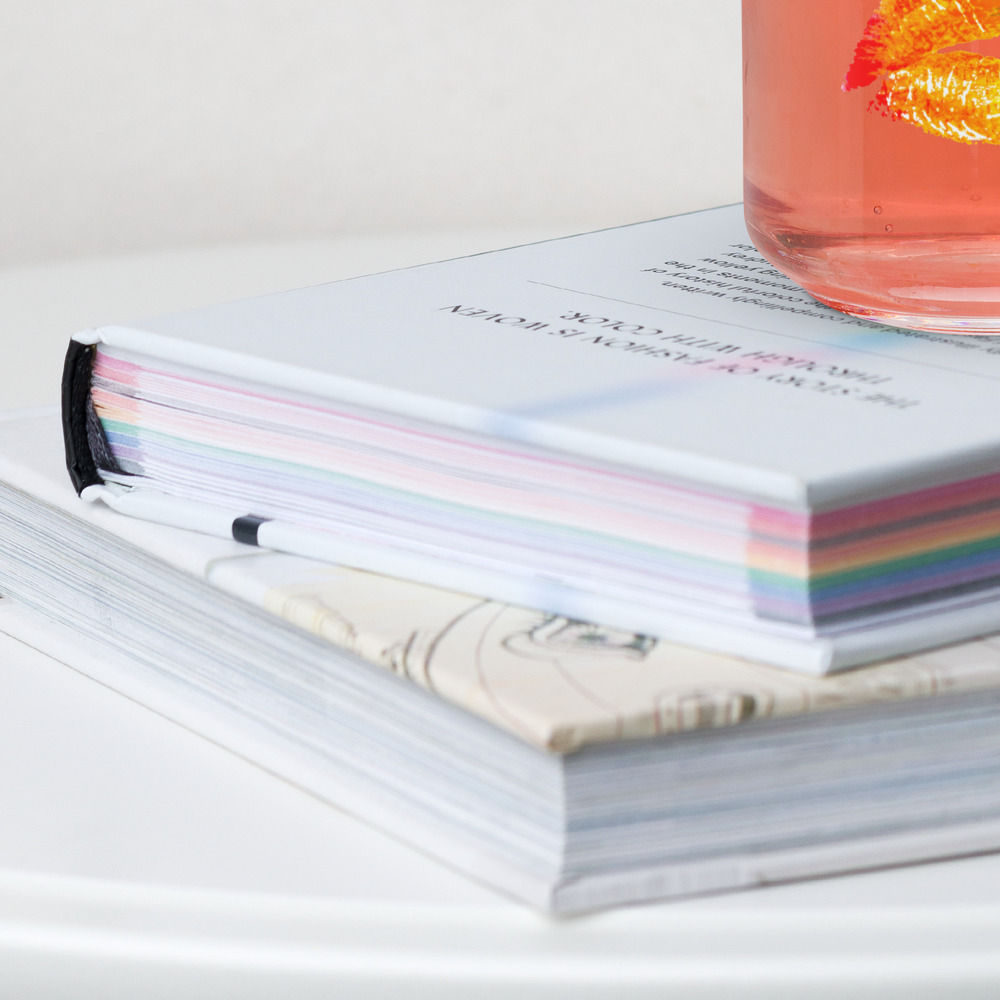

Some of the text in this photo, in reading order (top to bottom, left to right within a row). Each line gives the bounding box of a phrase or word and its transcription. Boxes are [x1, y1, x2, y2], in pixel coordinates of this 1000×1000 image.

[665, 261, 696, 269] the
[700, 258, 762, 271] yellow
[666, 272, 732, 288] history
[717, 272, 803, 291] moments
[728, 286, 803, 302] colorful
[730, 296, 853, 320] compellingly
[439, 304, 919, 408] THE STORY OF FASHION IS WOVEN
[560, 311, 890, 384] THROUGH WITH COLOR.
